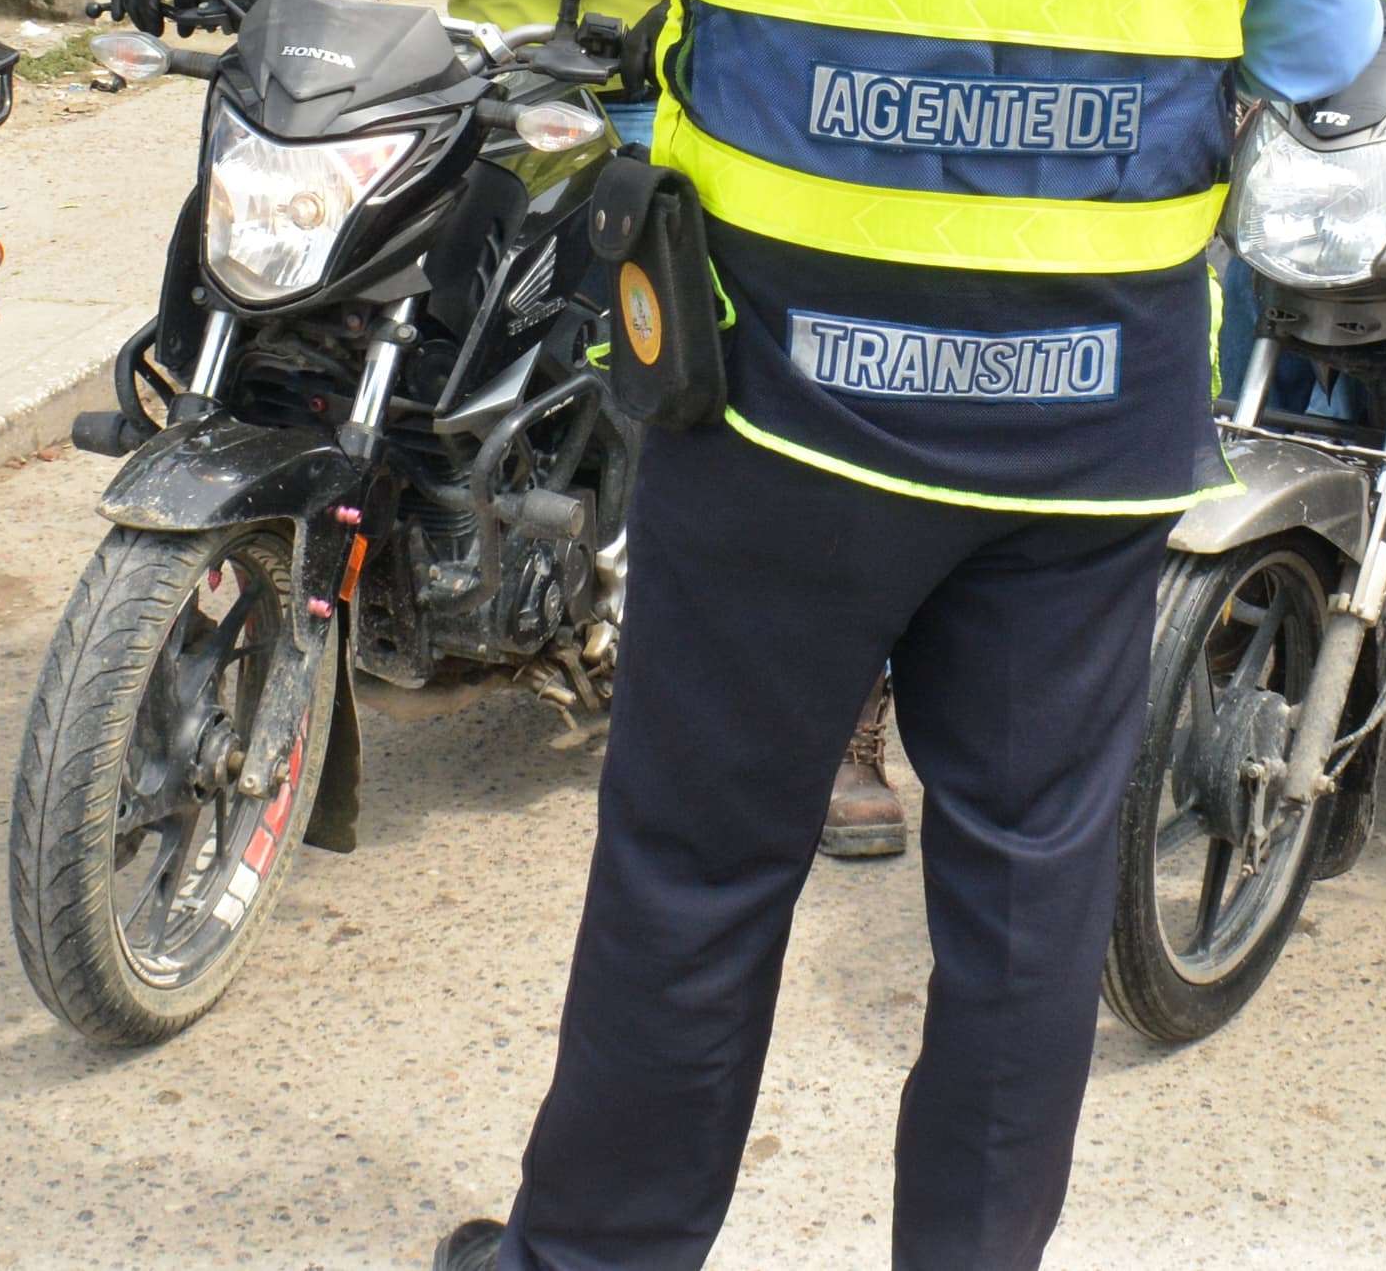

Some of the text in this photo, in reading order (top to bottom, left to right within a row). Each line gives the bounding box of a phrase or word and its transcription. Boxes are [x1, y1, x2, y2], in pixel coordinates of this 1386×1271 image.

[281, 45, 356, 69] HONDA
[819, 70, 1139, 150] AGENTE DE
[1313, 110, 1351, 127] TVS
[810, 320, 1105, 396] TRANSITO
